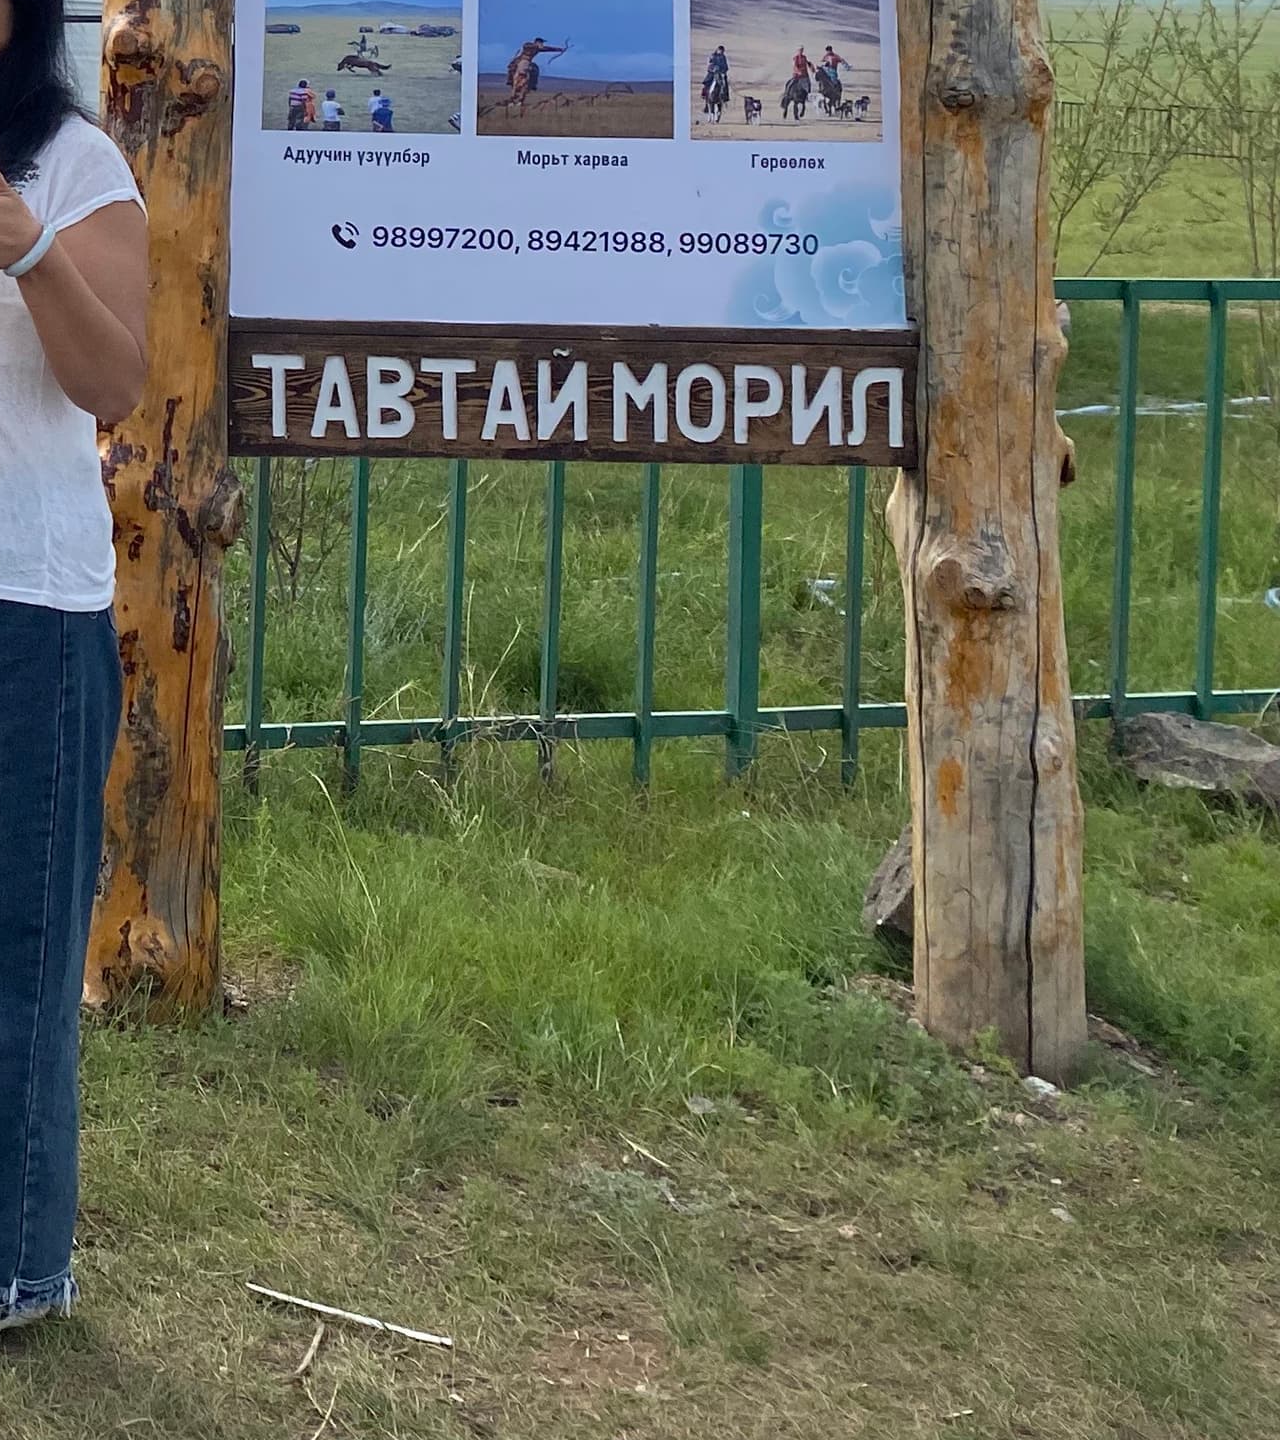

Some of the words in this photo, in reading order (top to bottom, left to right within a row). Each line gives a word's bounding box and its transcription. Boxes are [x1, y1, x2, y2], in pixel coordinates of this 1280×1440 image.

[283, 146, 352, 165] Адуучин
[357, 148, 430, 167] үзүүлбэр
[517, 150, 569, 169] Морьт
[574, 154, 628, 170] харваа
[751, 154, 825, 173] Гөрөөлөх
[373, 226, 520, 255] 98997200,
[527, 229, 672, 257] 89421988,
[679, 232, 818, 255] 99089730
[252, 349, 588, 441] ТАВТАЙ
[613, 362, 903, 447] МОРИЛ
